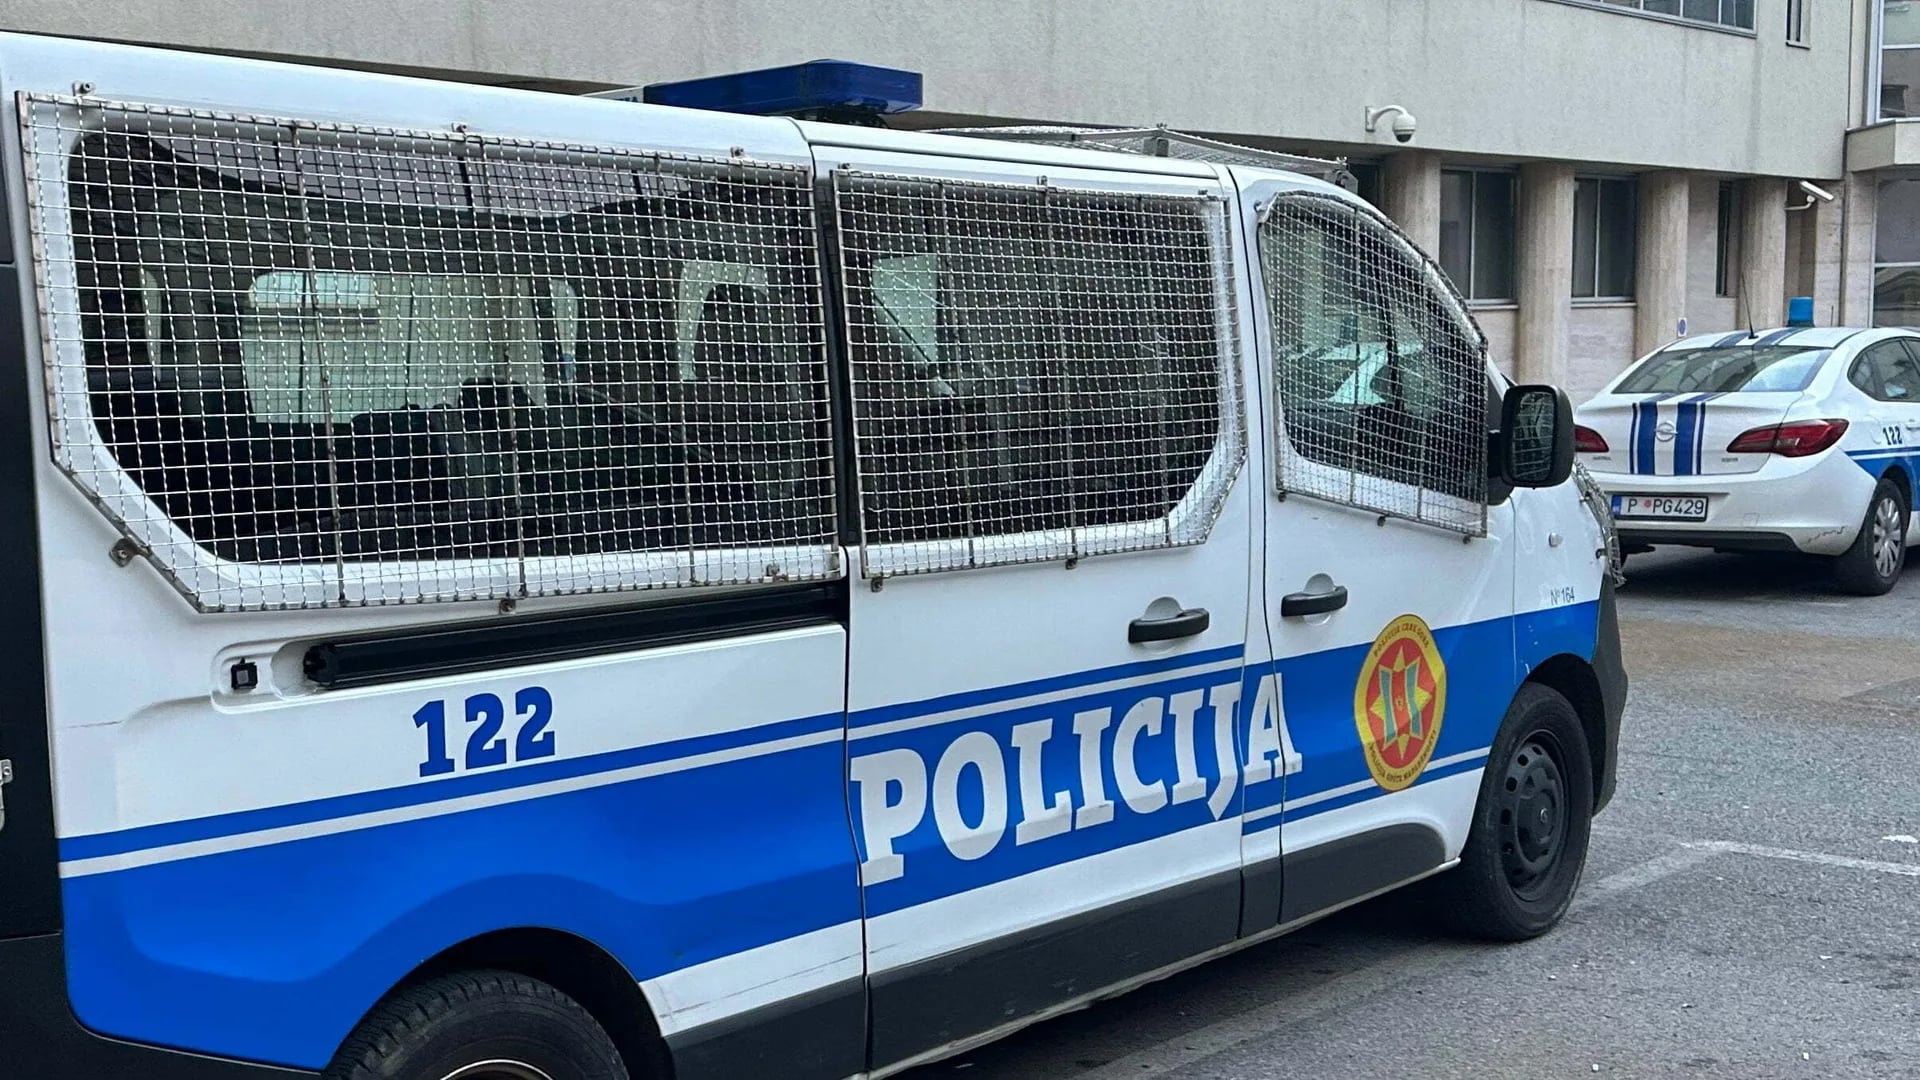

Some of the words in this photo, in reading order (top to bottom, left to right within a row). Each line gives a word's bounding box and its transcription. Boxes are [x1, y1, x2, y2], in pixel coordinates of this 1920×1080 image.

[1883, 425, 1903, 446] 122
[1627, 498, 1638, 513] P
[1652, 498, 1704, 515] PG429
[413, 686, 556, 777] 122
[850, 672, 1303, 887] POLICIJA
